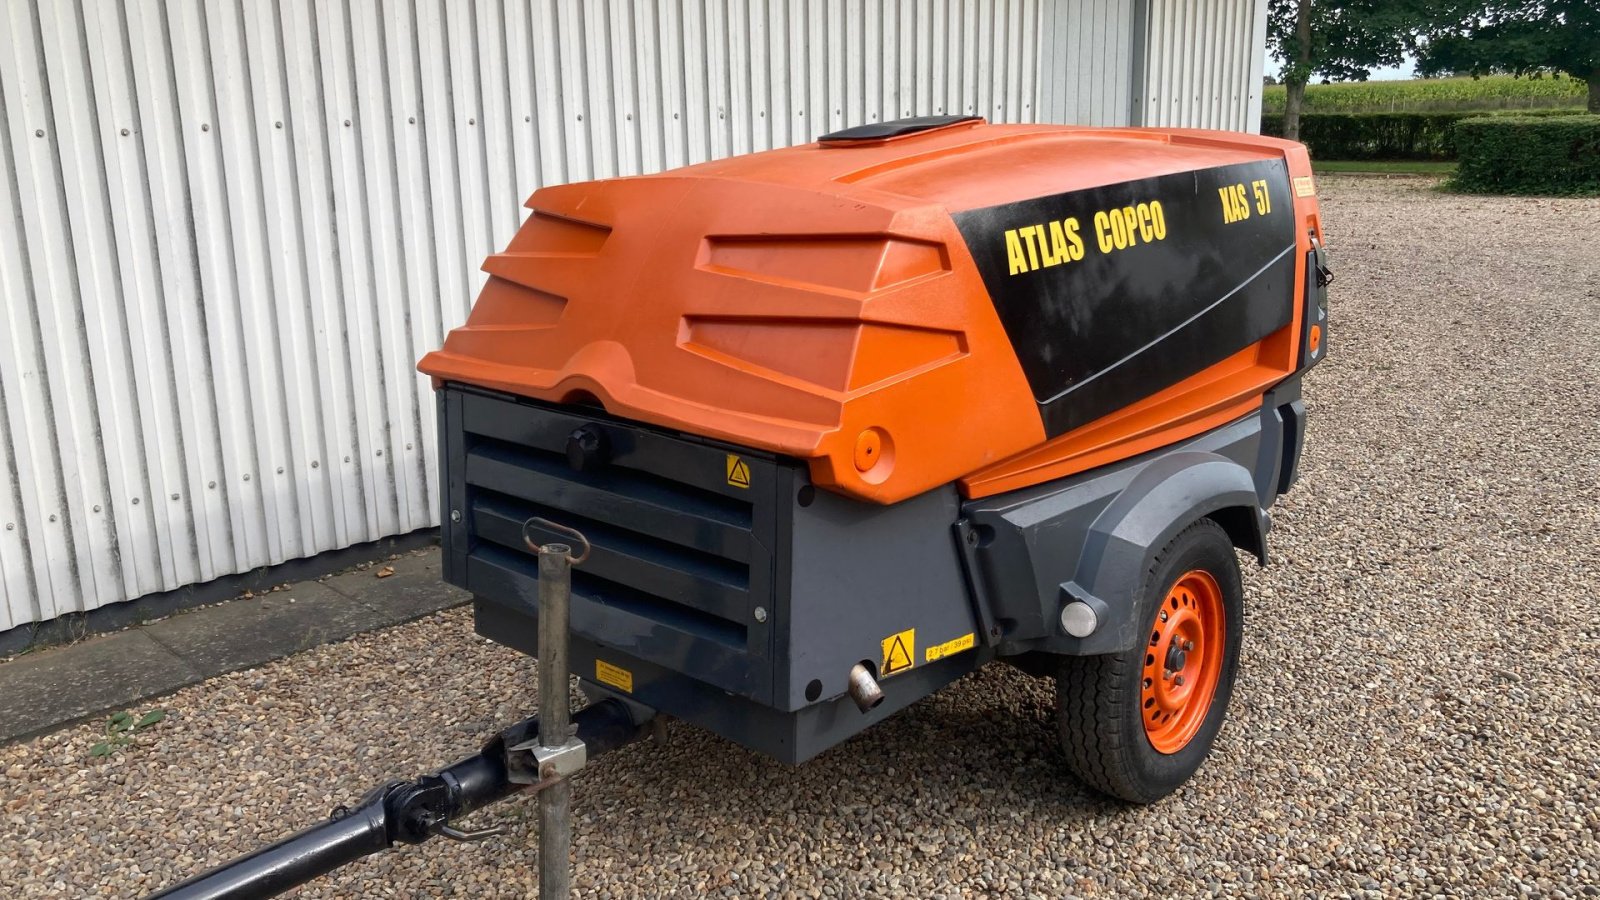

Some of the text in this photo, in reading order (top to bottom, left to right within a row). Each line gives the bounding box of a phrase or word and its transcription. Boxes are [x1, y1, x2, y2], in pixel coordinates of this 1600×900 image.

[1218, 183, 1250, 224] XAS
[1252, 180, 1271, 215] 57
[1005, 200, 1166, 276] ATLAS COPCO
